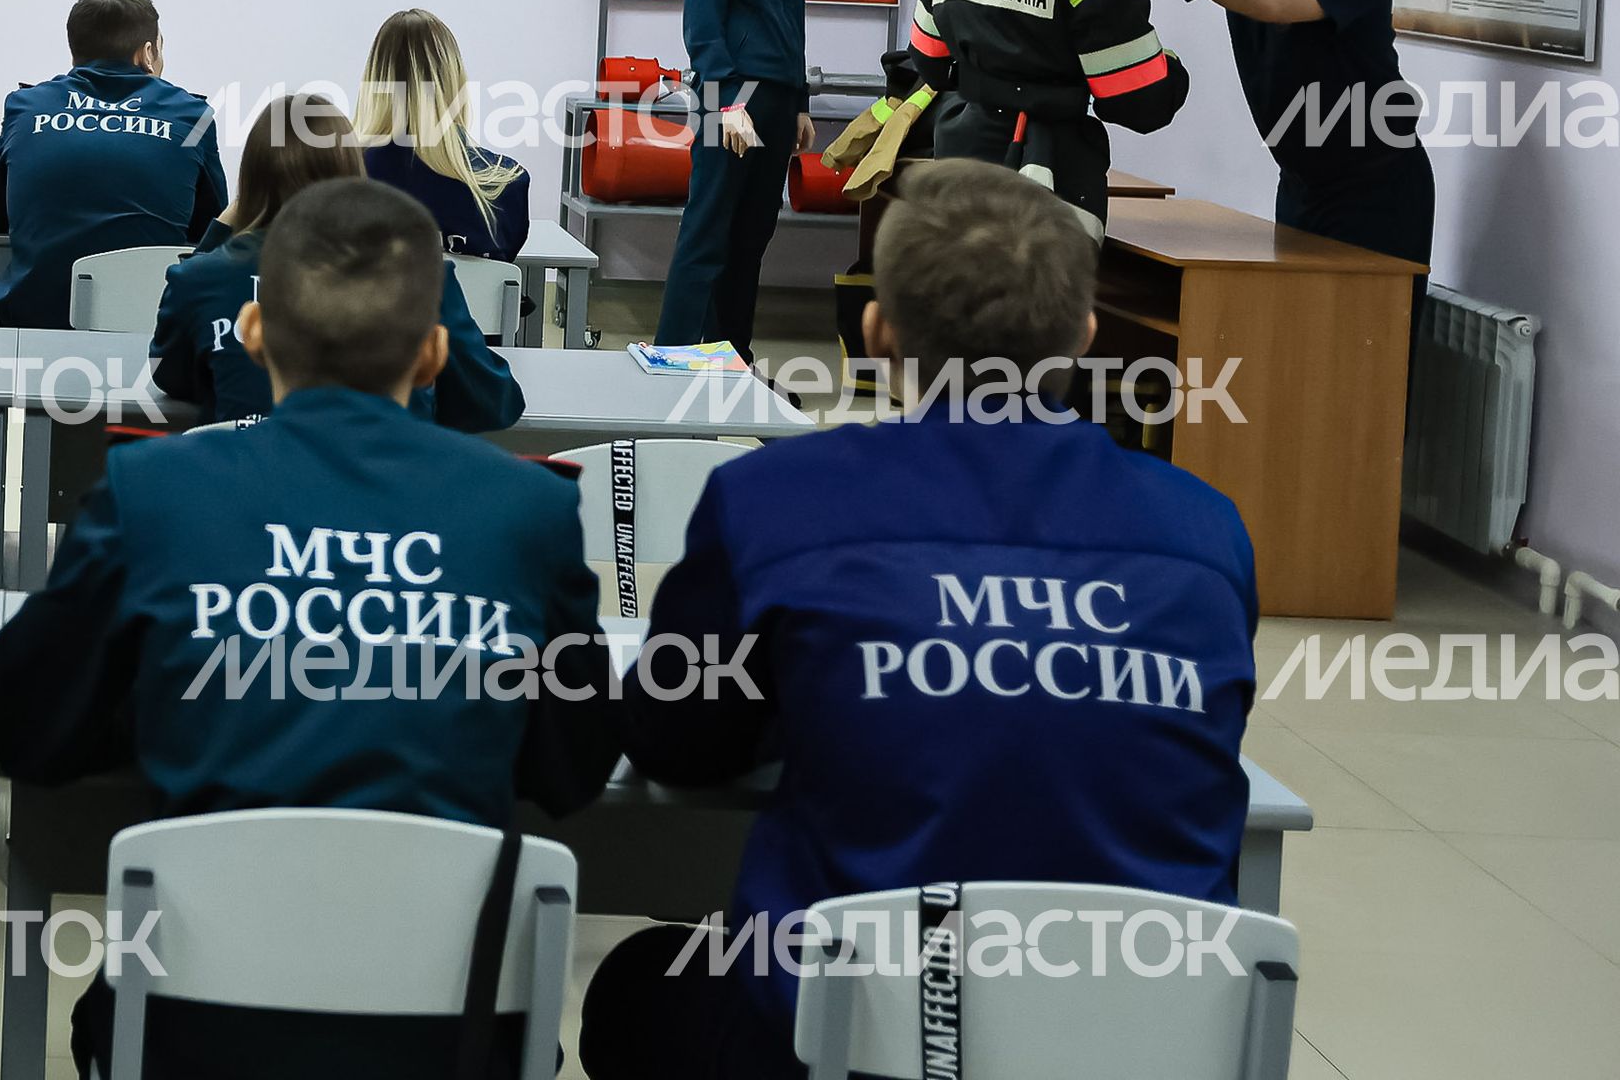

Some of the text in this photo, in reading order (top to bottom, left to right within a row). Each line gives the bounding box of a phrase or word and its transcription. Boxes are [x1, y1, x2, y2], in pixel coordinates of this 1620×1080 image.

[32, 113, 173, 142] РОССИИ
[65, 90, 142, 112] МЧС
[264, 522, 443, 585] МЧС
[615, 523, 637, 619] UNAFFECTED
[188, 582, 516, 656] РОССИИ
[930, 573, 1131, 634] МЧС
[855, 637, 1206, 714] РОССИИ
